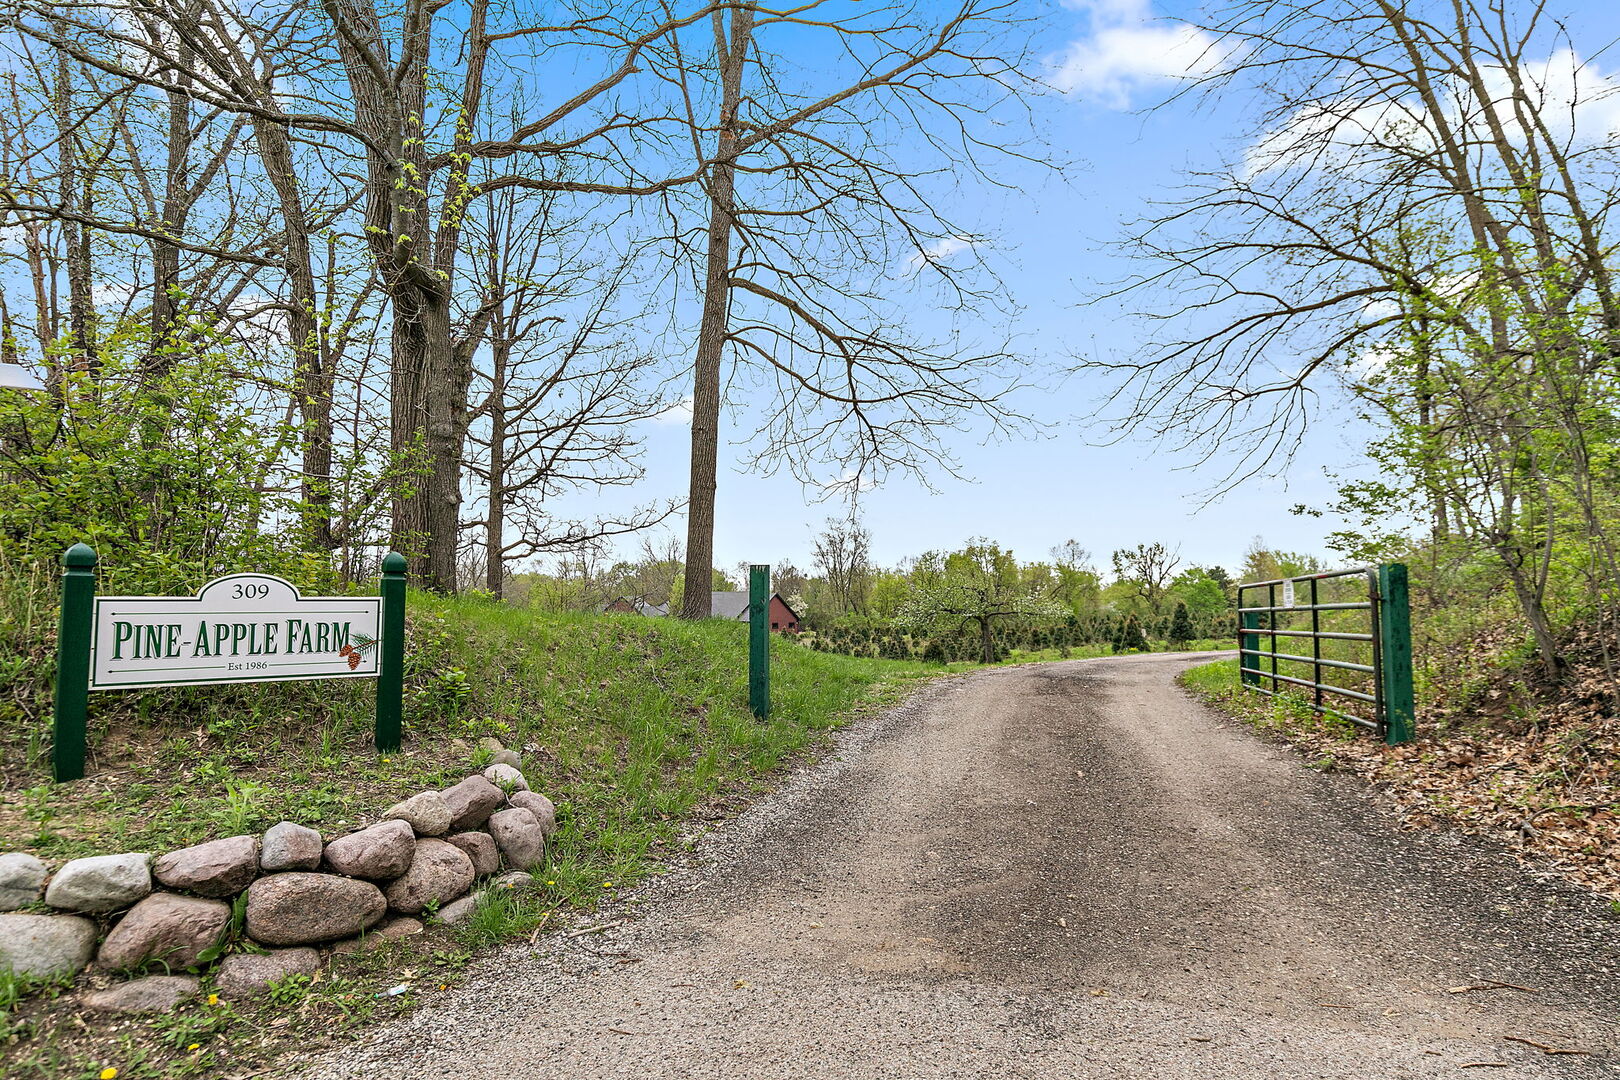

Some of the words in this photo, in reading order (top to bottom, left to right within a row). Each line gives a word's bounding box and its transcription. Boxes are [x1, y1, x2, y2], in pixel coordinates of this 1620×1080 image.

[232, 584, 269, 600] 309
[111, 620, 278, 661] PINE-APPLE
[284, 619, 351, 655] FARM
[228, 663, 243, 671] Est
[246, 661, 267, 670] 1986
